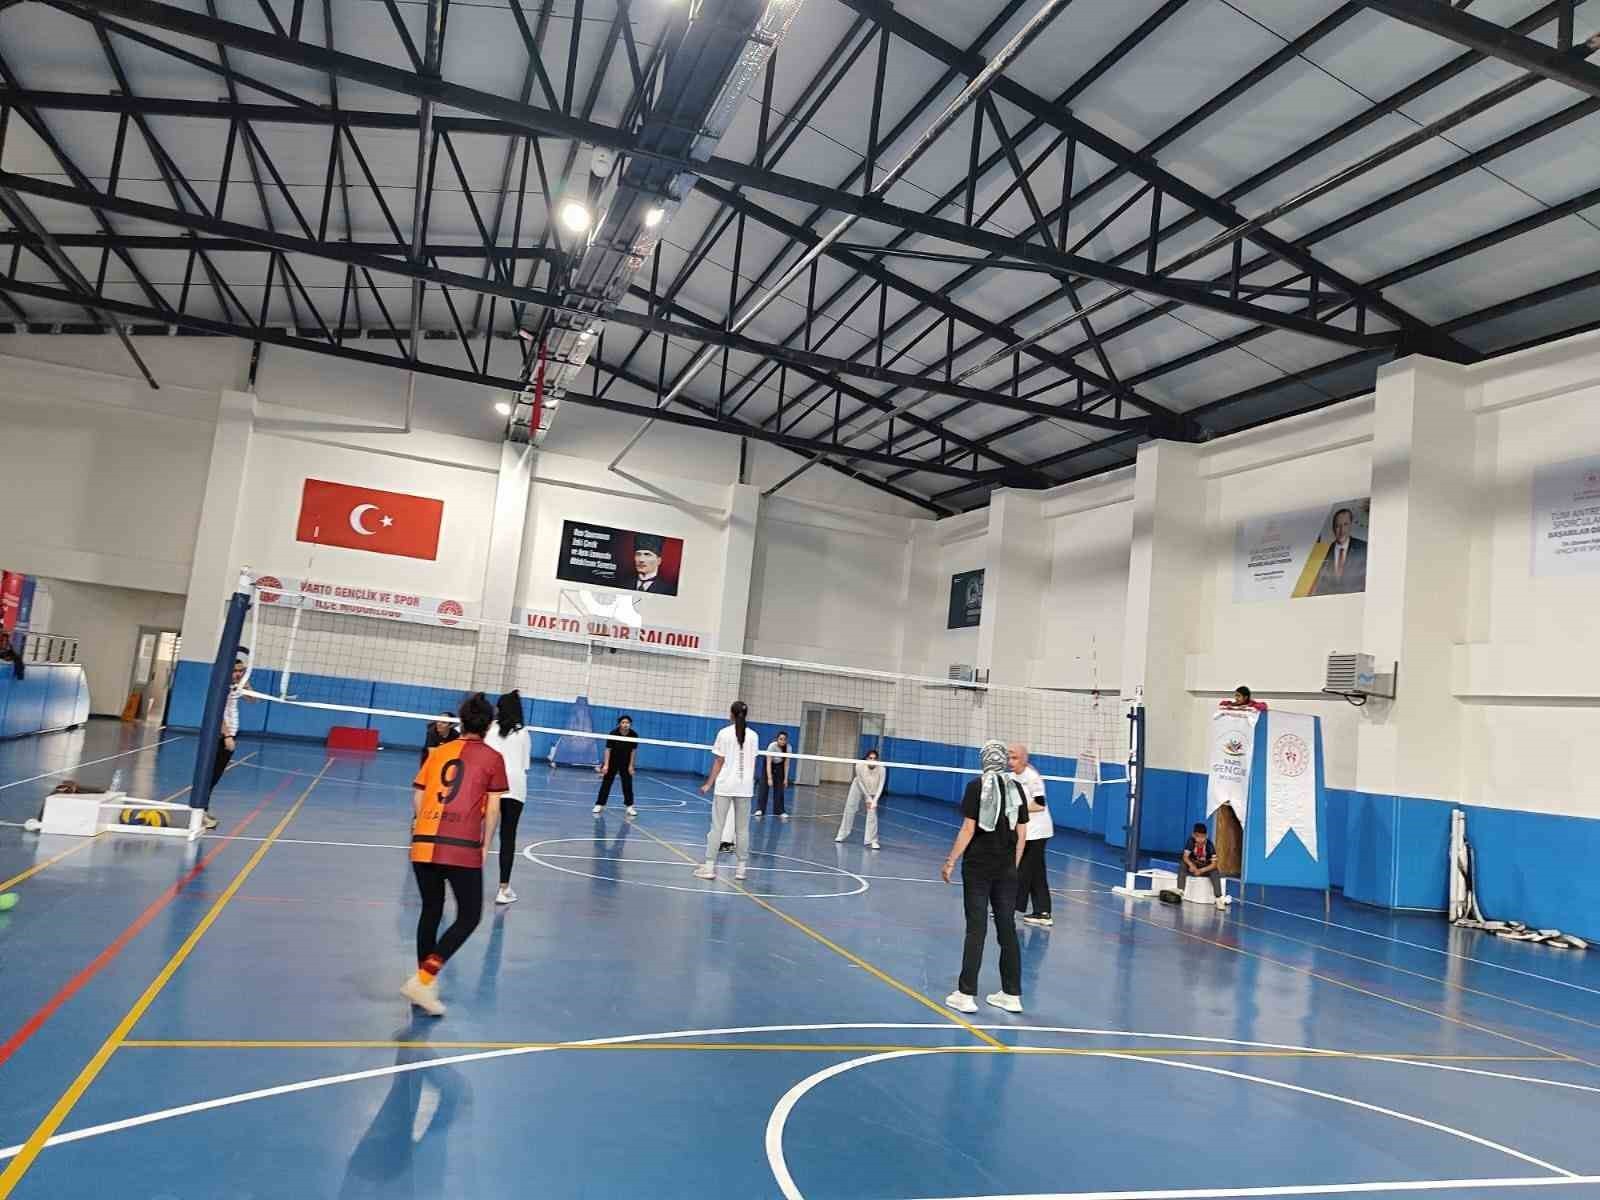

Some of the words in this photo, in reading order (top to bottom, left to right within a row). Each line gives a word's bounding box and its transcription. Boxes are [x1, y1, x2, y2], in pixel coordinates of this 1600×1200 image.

[301, 581, 332, 596] VARTO
[379, 593, 391, 603] VE
[394, 595, 421, 608] SPOR
[437, 758, 465, 805] 9
